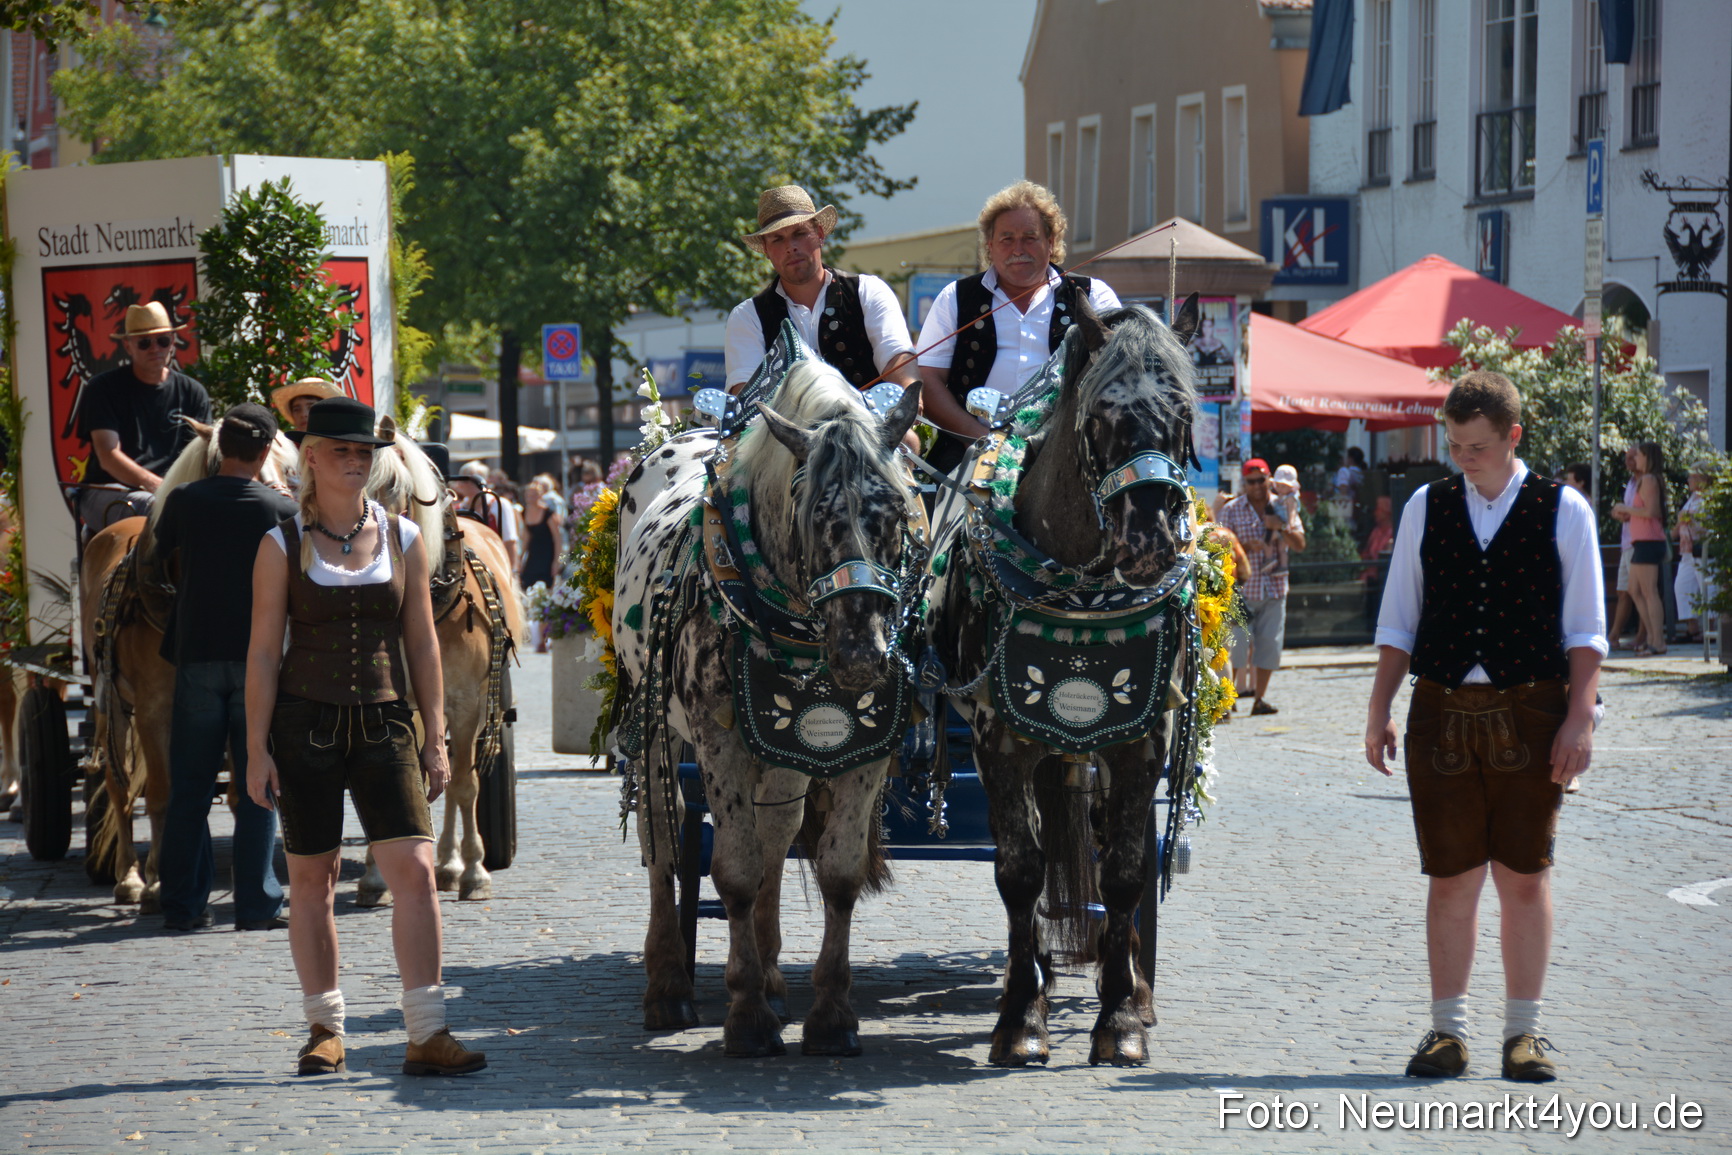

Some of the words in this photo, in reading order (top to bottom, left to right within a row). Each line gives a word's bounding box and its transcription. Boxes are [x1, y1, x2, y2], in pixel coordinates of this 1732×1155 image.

[1589, 149, 1600, 205] P
[38, 223, 90, 257] Stadt
[94, 216, 196, 253] Neumarkt
[549, 361, 577, 376] TAXI
[1278, 395, 1316, 407] Hotel
[1319, 397, 1393, 413] Restaurant
[1396, 400, 1435, 415] Lehm
[1058, 691, 1099, 701] Holzrückerei
[1059, 702, 1097, 713] Weismann
[805, 717, 845, 725] Holzrückerei
[806, 729, 844, 737] Weismann
